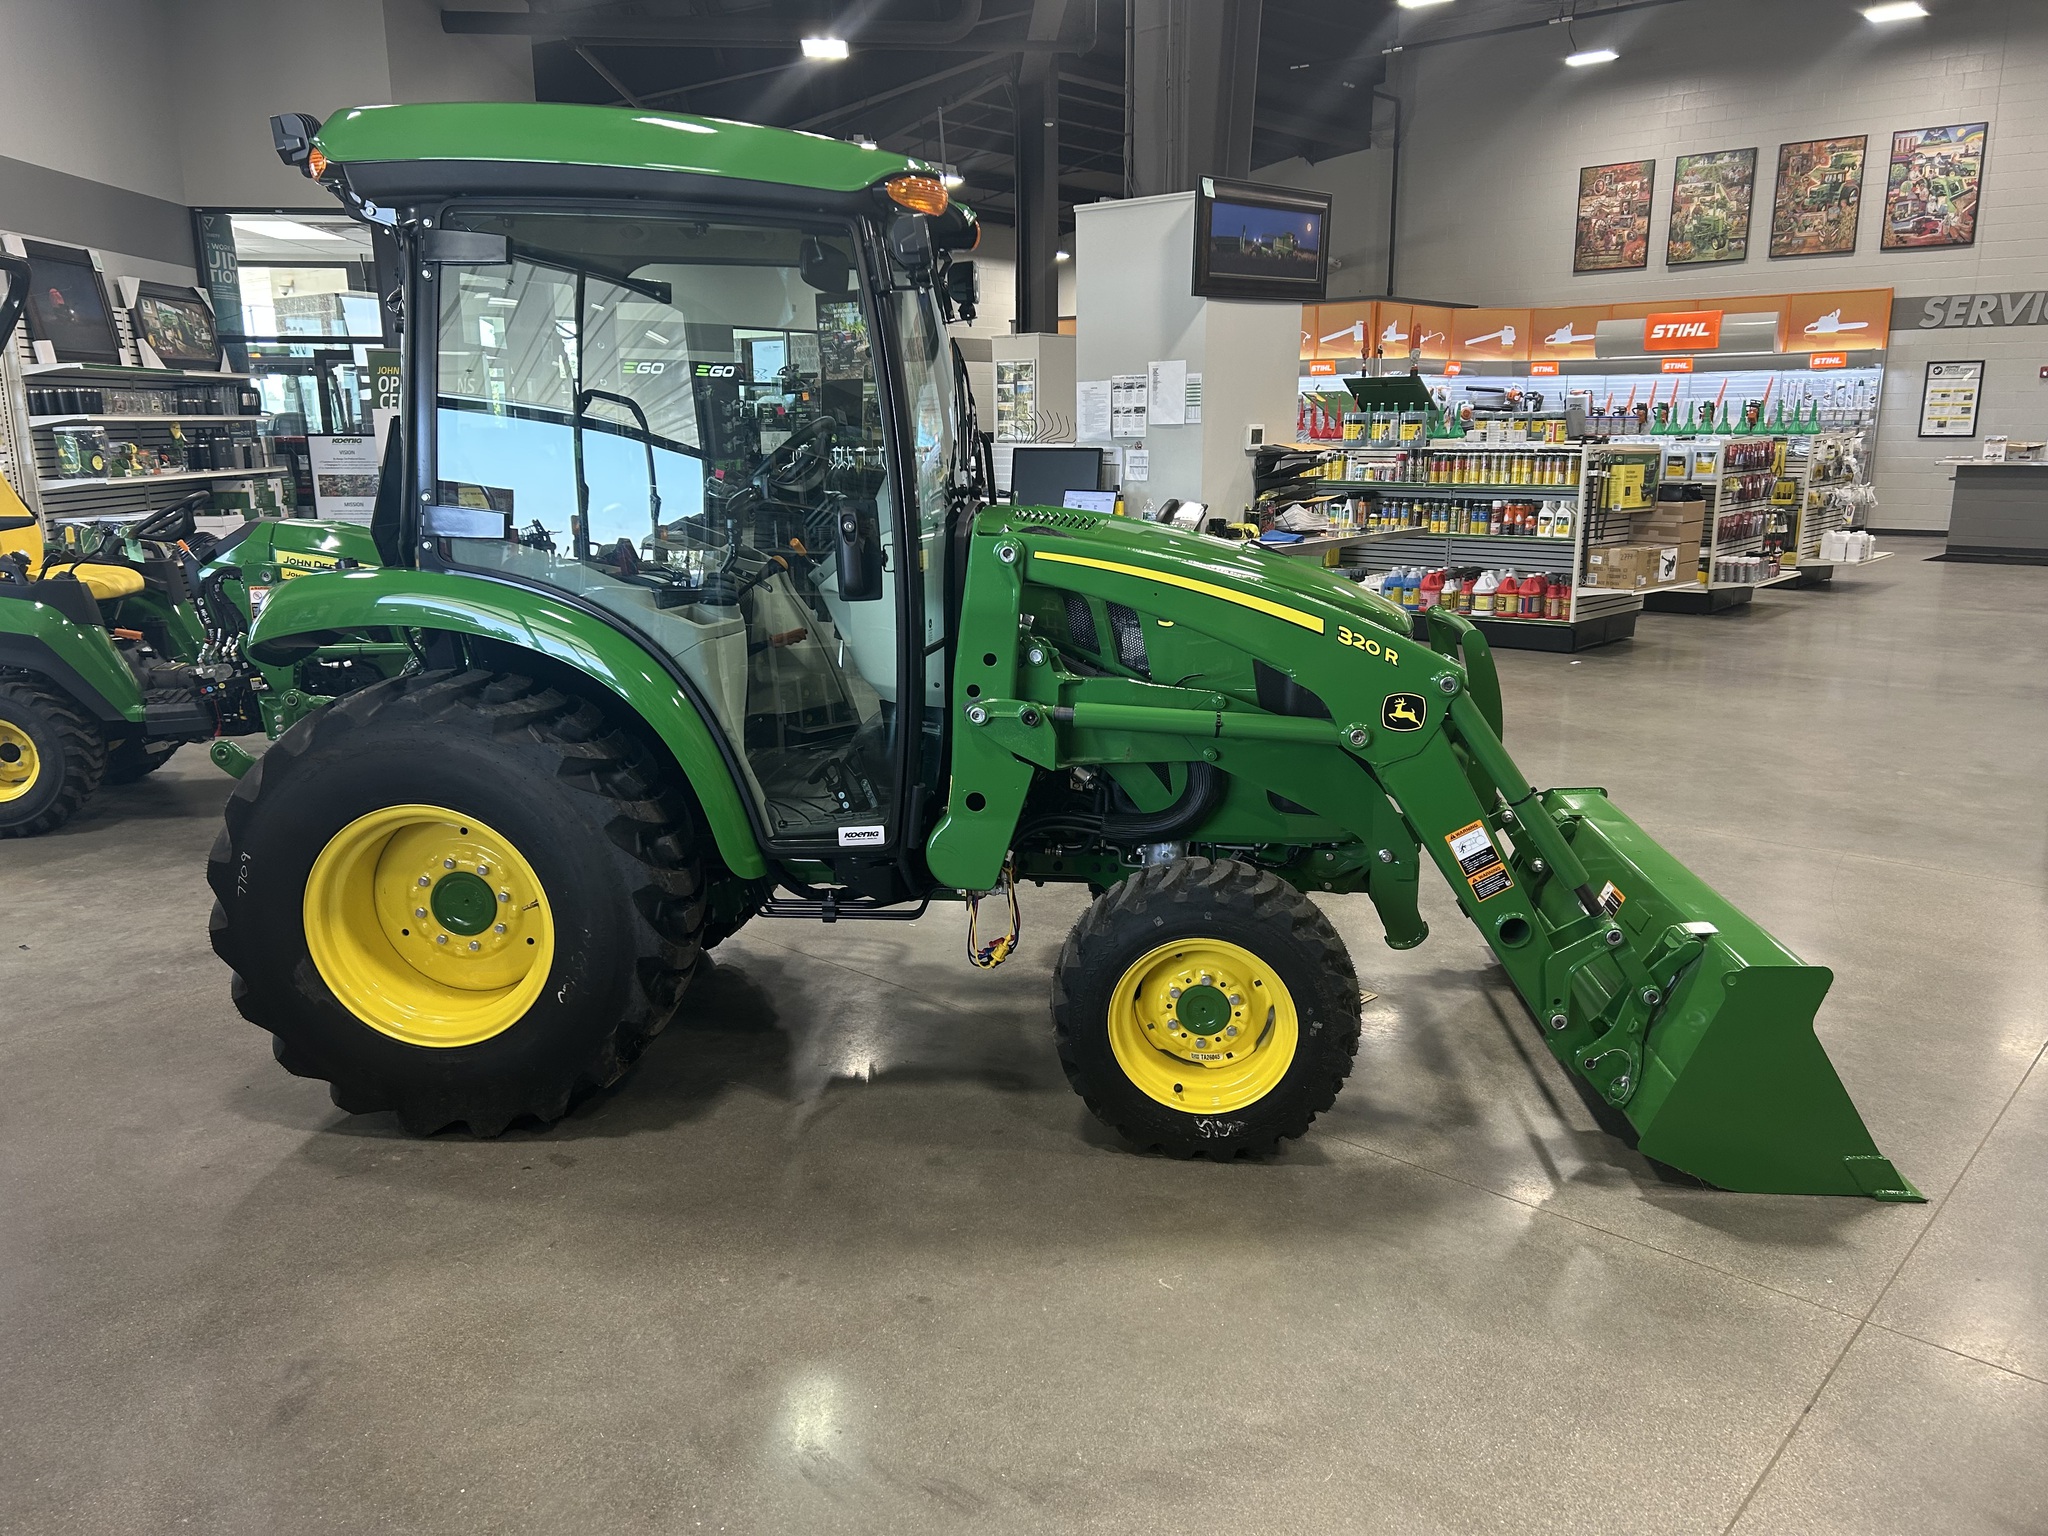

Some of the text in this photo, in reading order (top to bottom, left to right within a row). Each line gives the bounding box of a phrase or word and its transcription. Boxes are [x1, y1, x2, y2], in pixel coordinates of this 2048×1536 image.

[1919, 293, 2048, 328] SERVI
[1651, 322, 1710, 338] STIHL
[622, 361, 666, 375] EGO
[1813, 356, 1843, 365] STIHL
[377, 366, 400, 375] JOHN
[695, 364, 735, 378] EGO
[1532, 365, 1556, 373] STIHL
[378, 376, 400, 392] OP
[379, 393, 402, 409] CE
[283, 556, 312, 567] JOHN
[1337, 625, 1400, 668] 320 R
[1455, 823, 1479, 838] WARNING
[1478, 865, 1502, 880] WARNING
